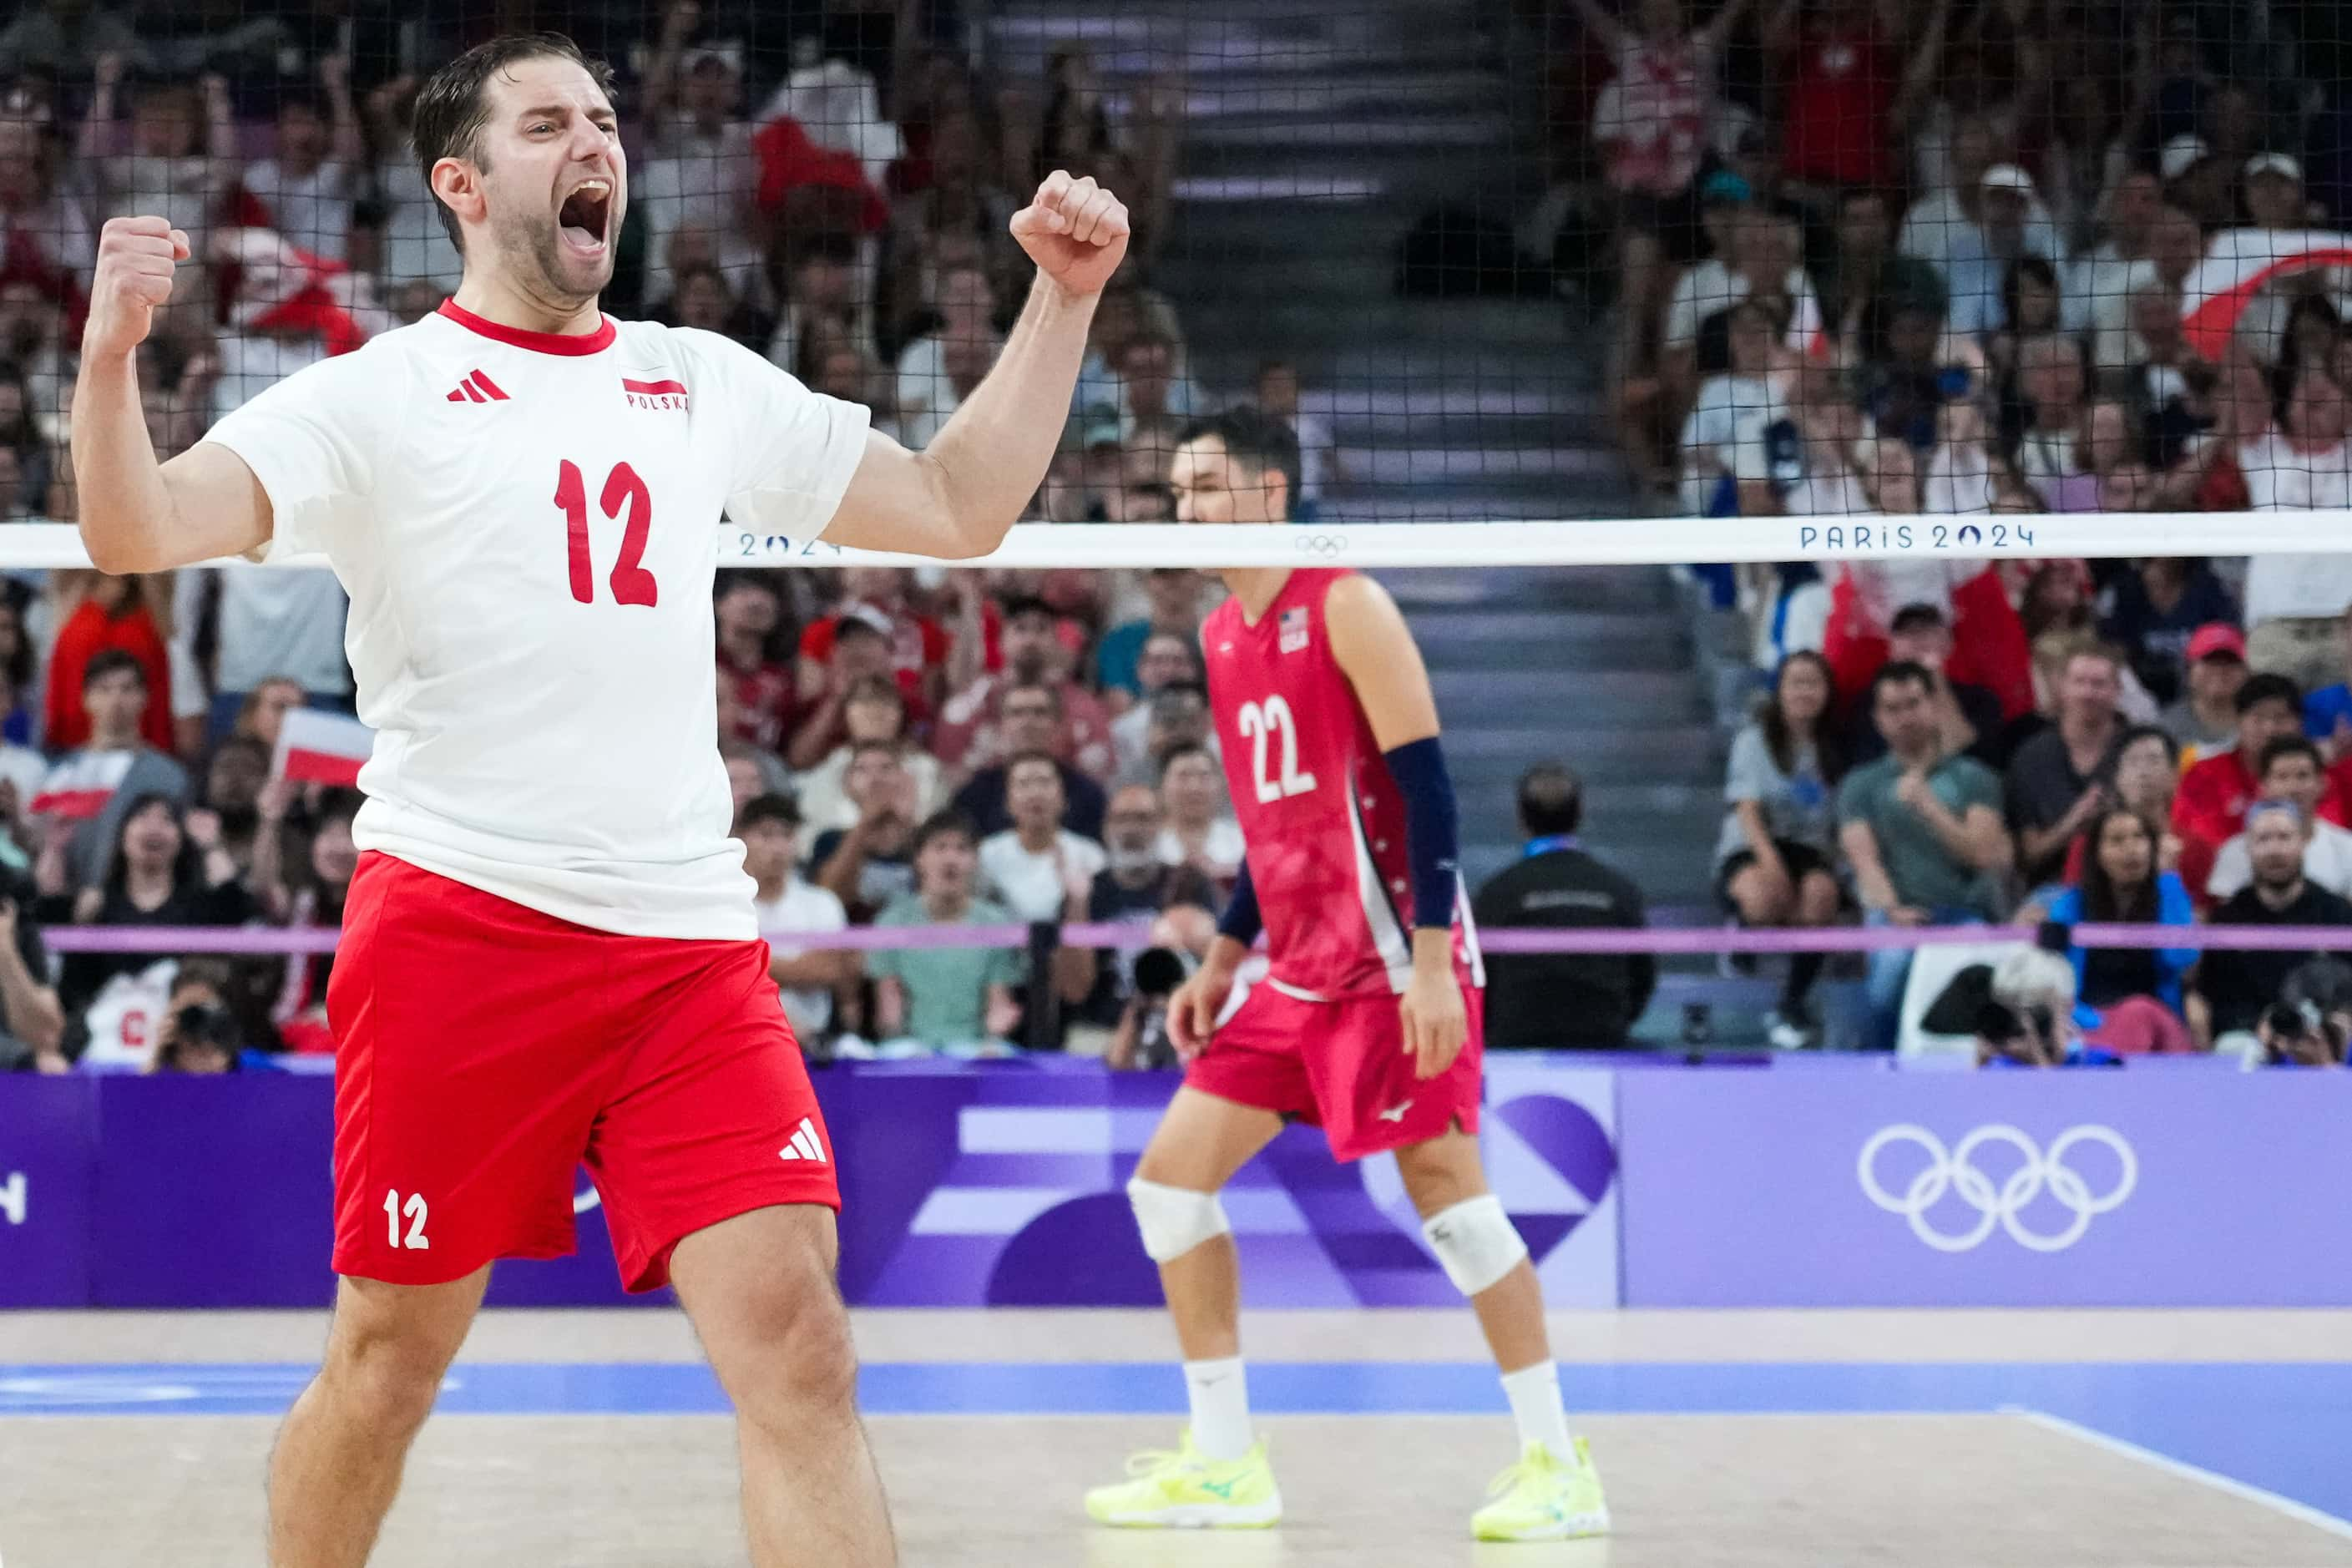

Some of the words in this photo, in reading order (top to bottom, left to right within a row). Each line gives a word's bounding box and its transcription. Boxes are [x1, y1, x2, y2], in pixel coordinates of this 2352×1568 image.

[554, 458, 658, 609] 12
[1931, 524, 2034, 549] 2024
[1238, 694, 1318, 804] 22
[383, 1188, 429, 1250] 12
